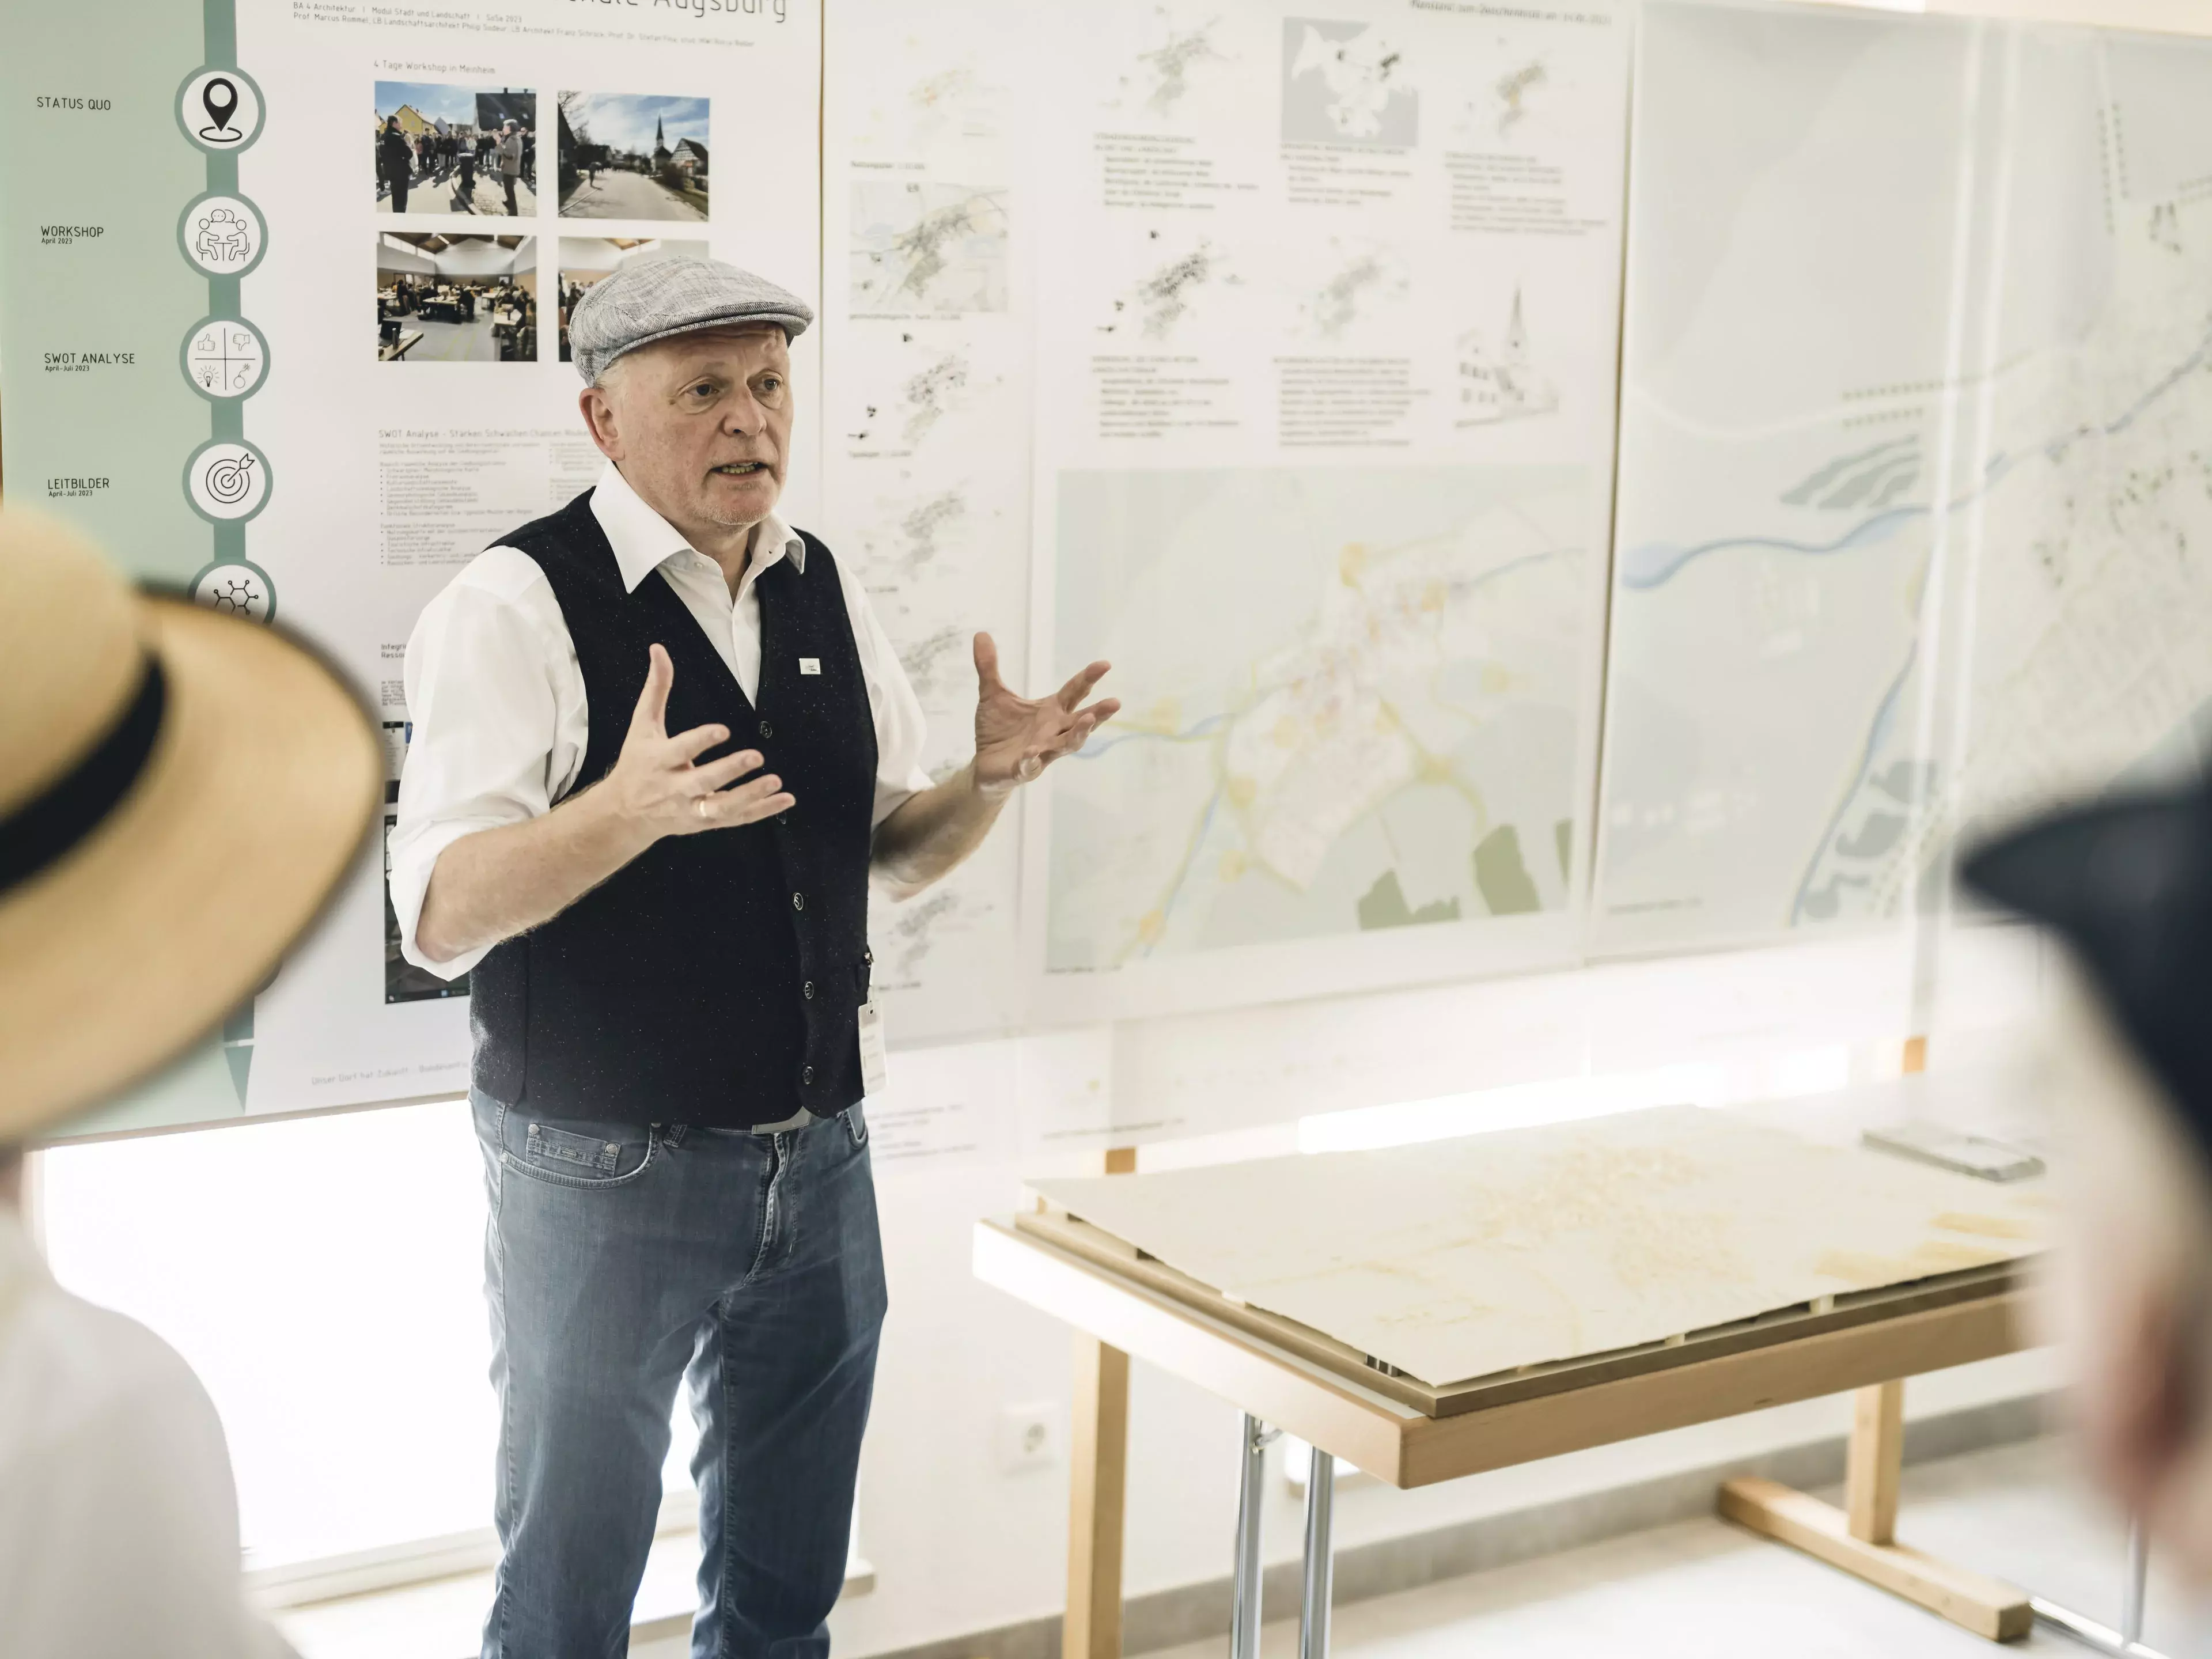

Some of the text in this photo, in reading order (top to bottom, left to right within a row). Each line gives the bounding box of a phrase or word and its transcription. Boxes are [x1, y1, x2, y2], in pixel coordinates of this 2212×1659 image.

[314, 3, 355, 13] Architektur
[372, 7, 392, 15] Modul
[395, 8, 414, 16] Stadt
[315, 13, 340, 22] Marcus
[383, 60, 403, 71] Tage
[406, 62, 447, 74] Workshop
[449, 63, 457, 71] in
[37, 97, 111, 111] STATUS QUO
[41, 225, 104, 237] WORKSHOP
[44, 353, 135, 364] SWOT ANALYSE
[378, 429, 402, 438] SWOT
[406, 430, 440, 440] Analyse
[48, 478, 109, 490] LEITBILDER
